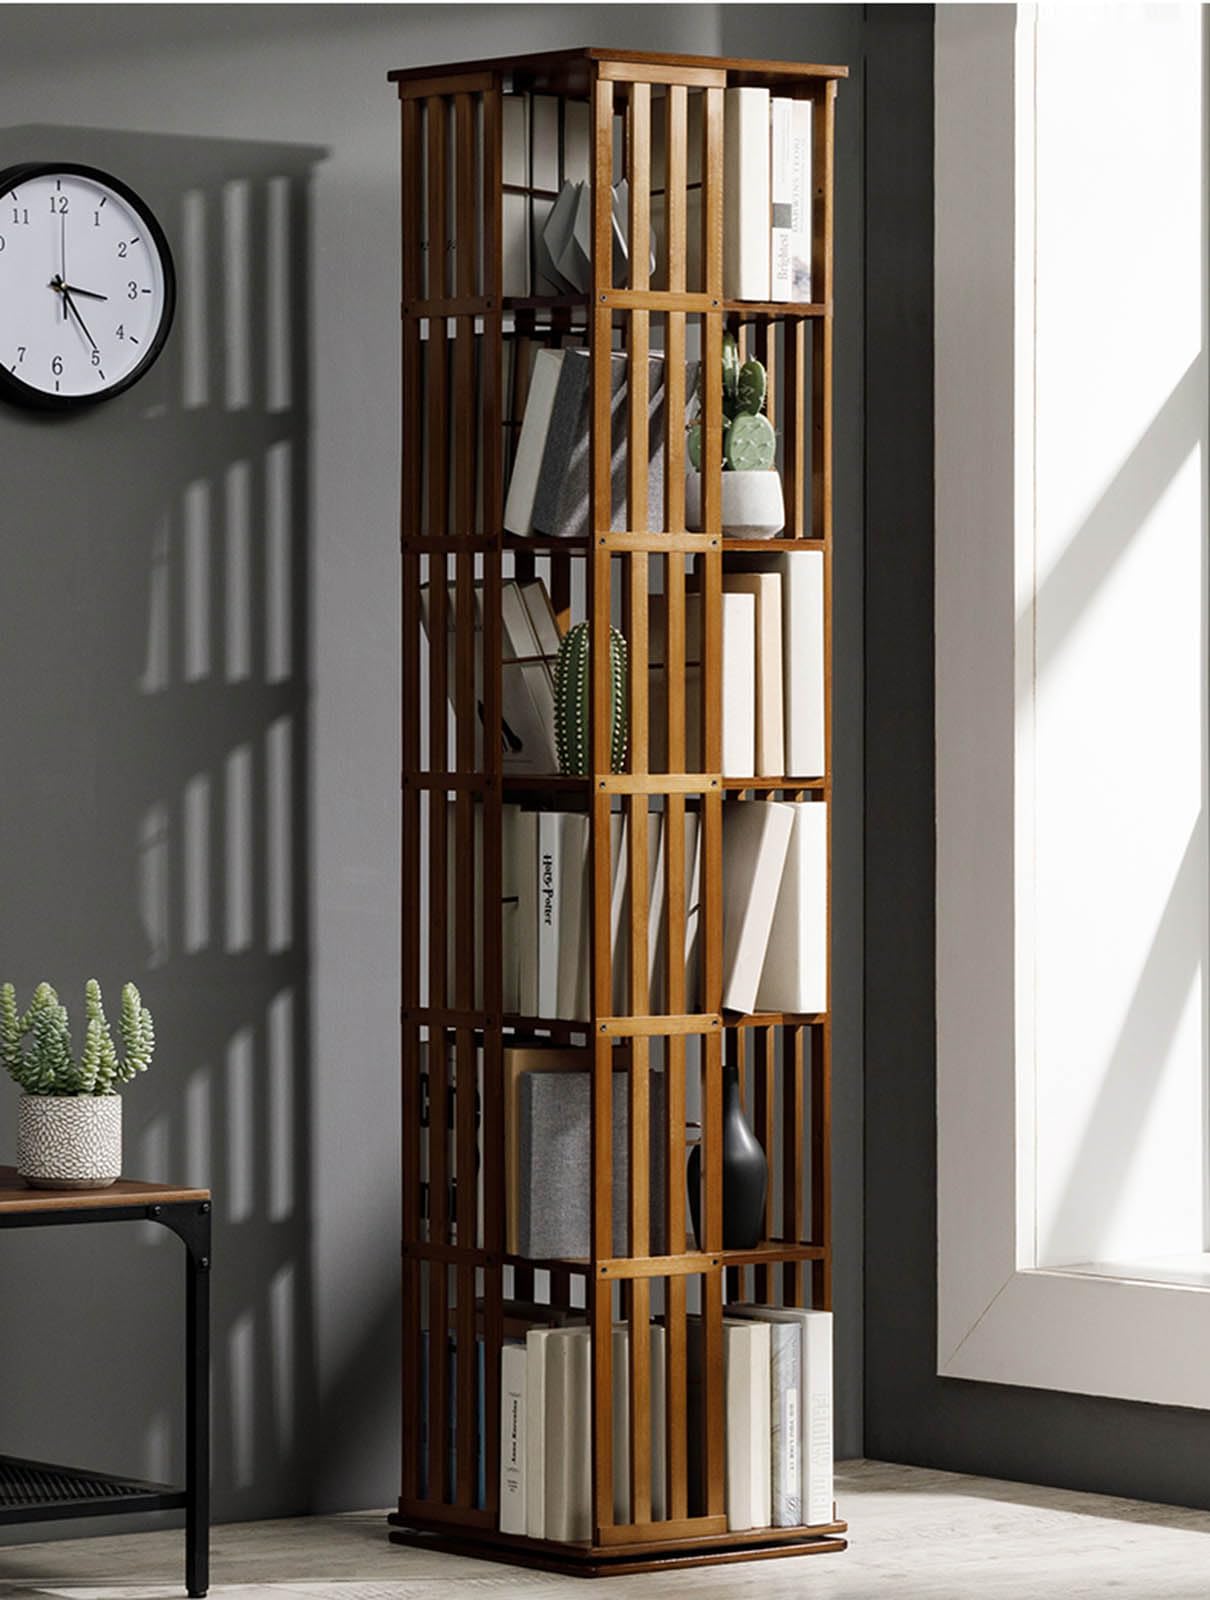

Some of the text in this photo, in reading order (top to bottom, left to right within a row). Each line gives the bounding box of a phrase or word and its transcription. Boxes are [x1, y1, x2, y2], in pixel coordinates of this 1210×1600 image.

[50, 198, 68, 213] 12
[13, 210, 29, 224] 11
[94, 212, 101, 226] 1
[118, 242, 128, 258] 2
[128, 282, 138, 299] 3
[116, 325, 125, 340] 4
[17, 347, 27, 363] 7
[90, 350, 100, 366] 5
[51, 356, 64, 375] 6
[542, 855, 553, 926] Harry Potter
